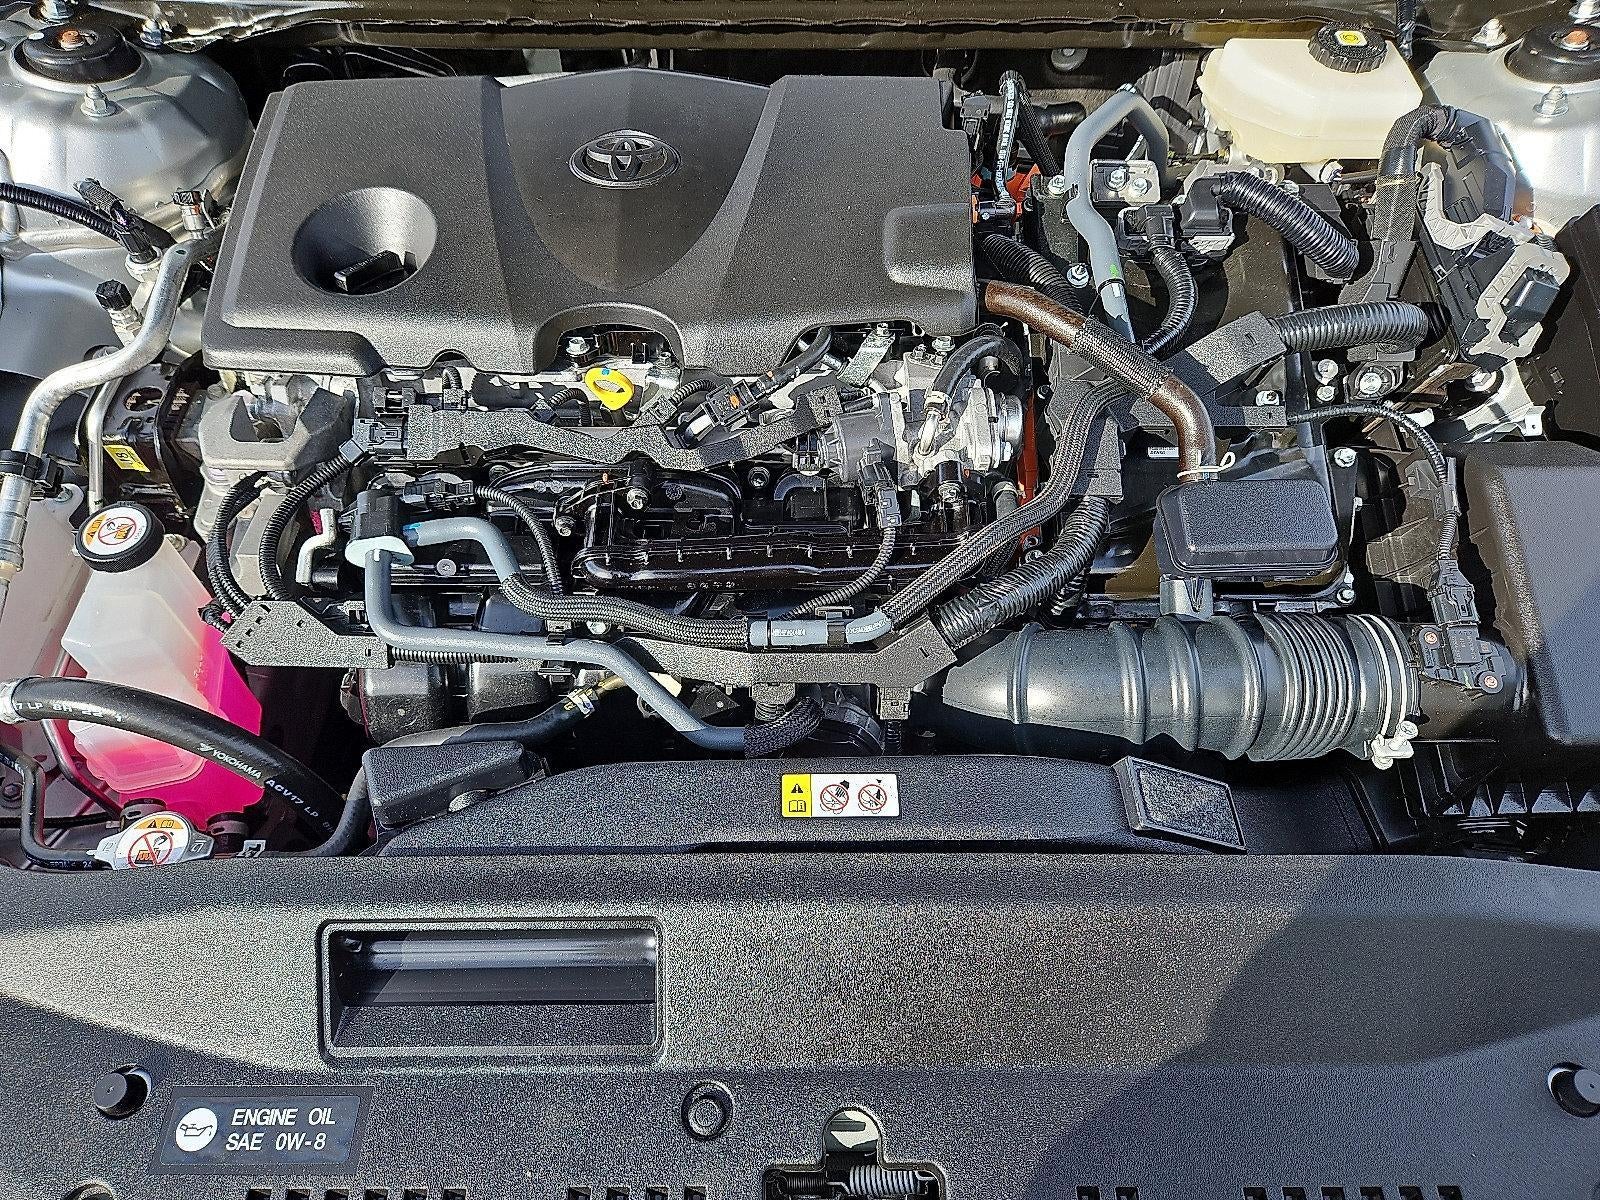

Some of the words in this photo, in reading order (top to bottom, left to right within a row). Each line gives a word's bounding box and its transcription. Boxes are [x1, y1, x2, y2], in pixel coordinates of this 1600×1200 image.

[212, 748, 262, 780] YOKOHAMA
[265, 779, 305, 804] ACV17
[230, 1107, 299, 1127] ENGINE
[308, 1107, 336, 1126] OIL
[225, 1132, 265, 1151] SAE
[275, 1132, 327, 1151] 0W-8
